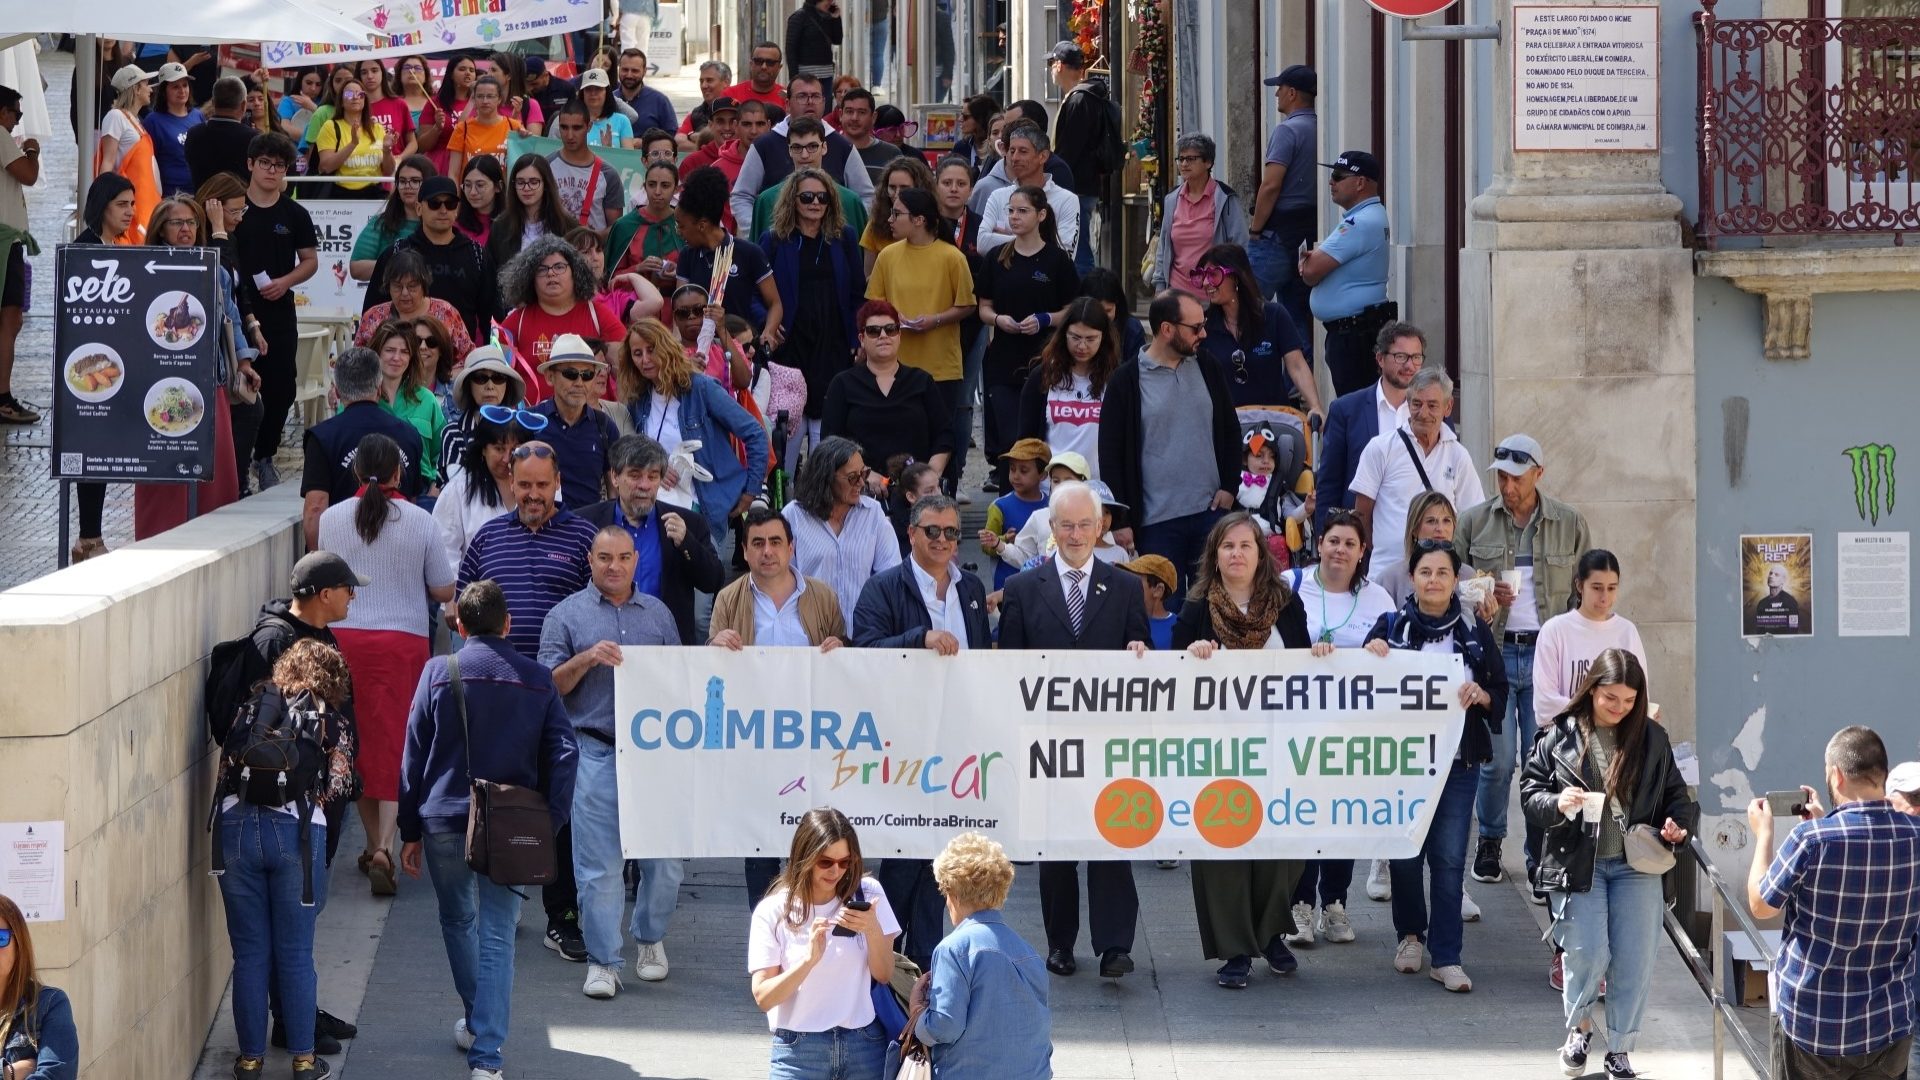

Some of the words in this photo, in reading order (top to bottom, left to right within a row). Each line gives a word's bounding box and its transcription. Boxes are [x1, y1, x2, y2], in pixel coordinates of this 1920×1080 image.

[531, 18, 548, 28] maio
[550, 16, 568, 25] 2023
[1536, 54, 1566, 62] EXÉRCITO
[1757, 544, 1796, 553] FILIPE
[1764, 552, 1789, 561] RET
[1019, 676, 1176, 712] VENHAM
[1194, 674, 1448, 710] DIVERTIR-SE
[631, 676, 883, 750] COIMBRA
[779, 776, 807, 796] a
[830, 740, 1003, 801] brincar
[1030, 739, 1084, 778] NO
[1104, 737, 1267, 777] PARQUE
[1288, 734, 1436, 776] VERDE!
[1106, 789, 1155, 830] 28
[1168, 800, 1190, 826] e
[1203, 788, 1254, 827] 29
[1268, 787, 1317, 826] de
